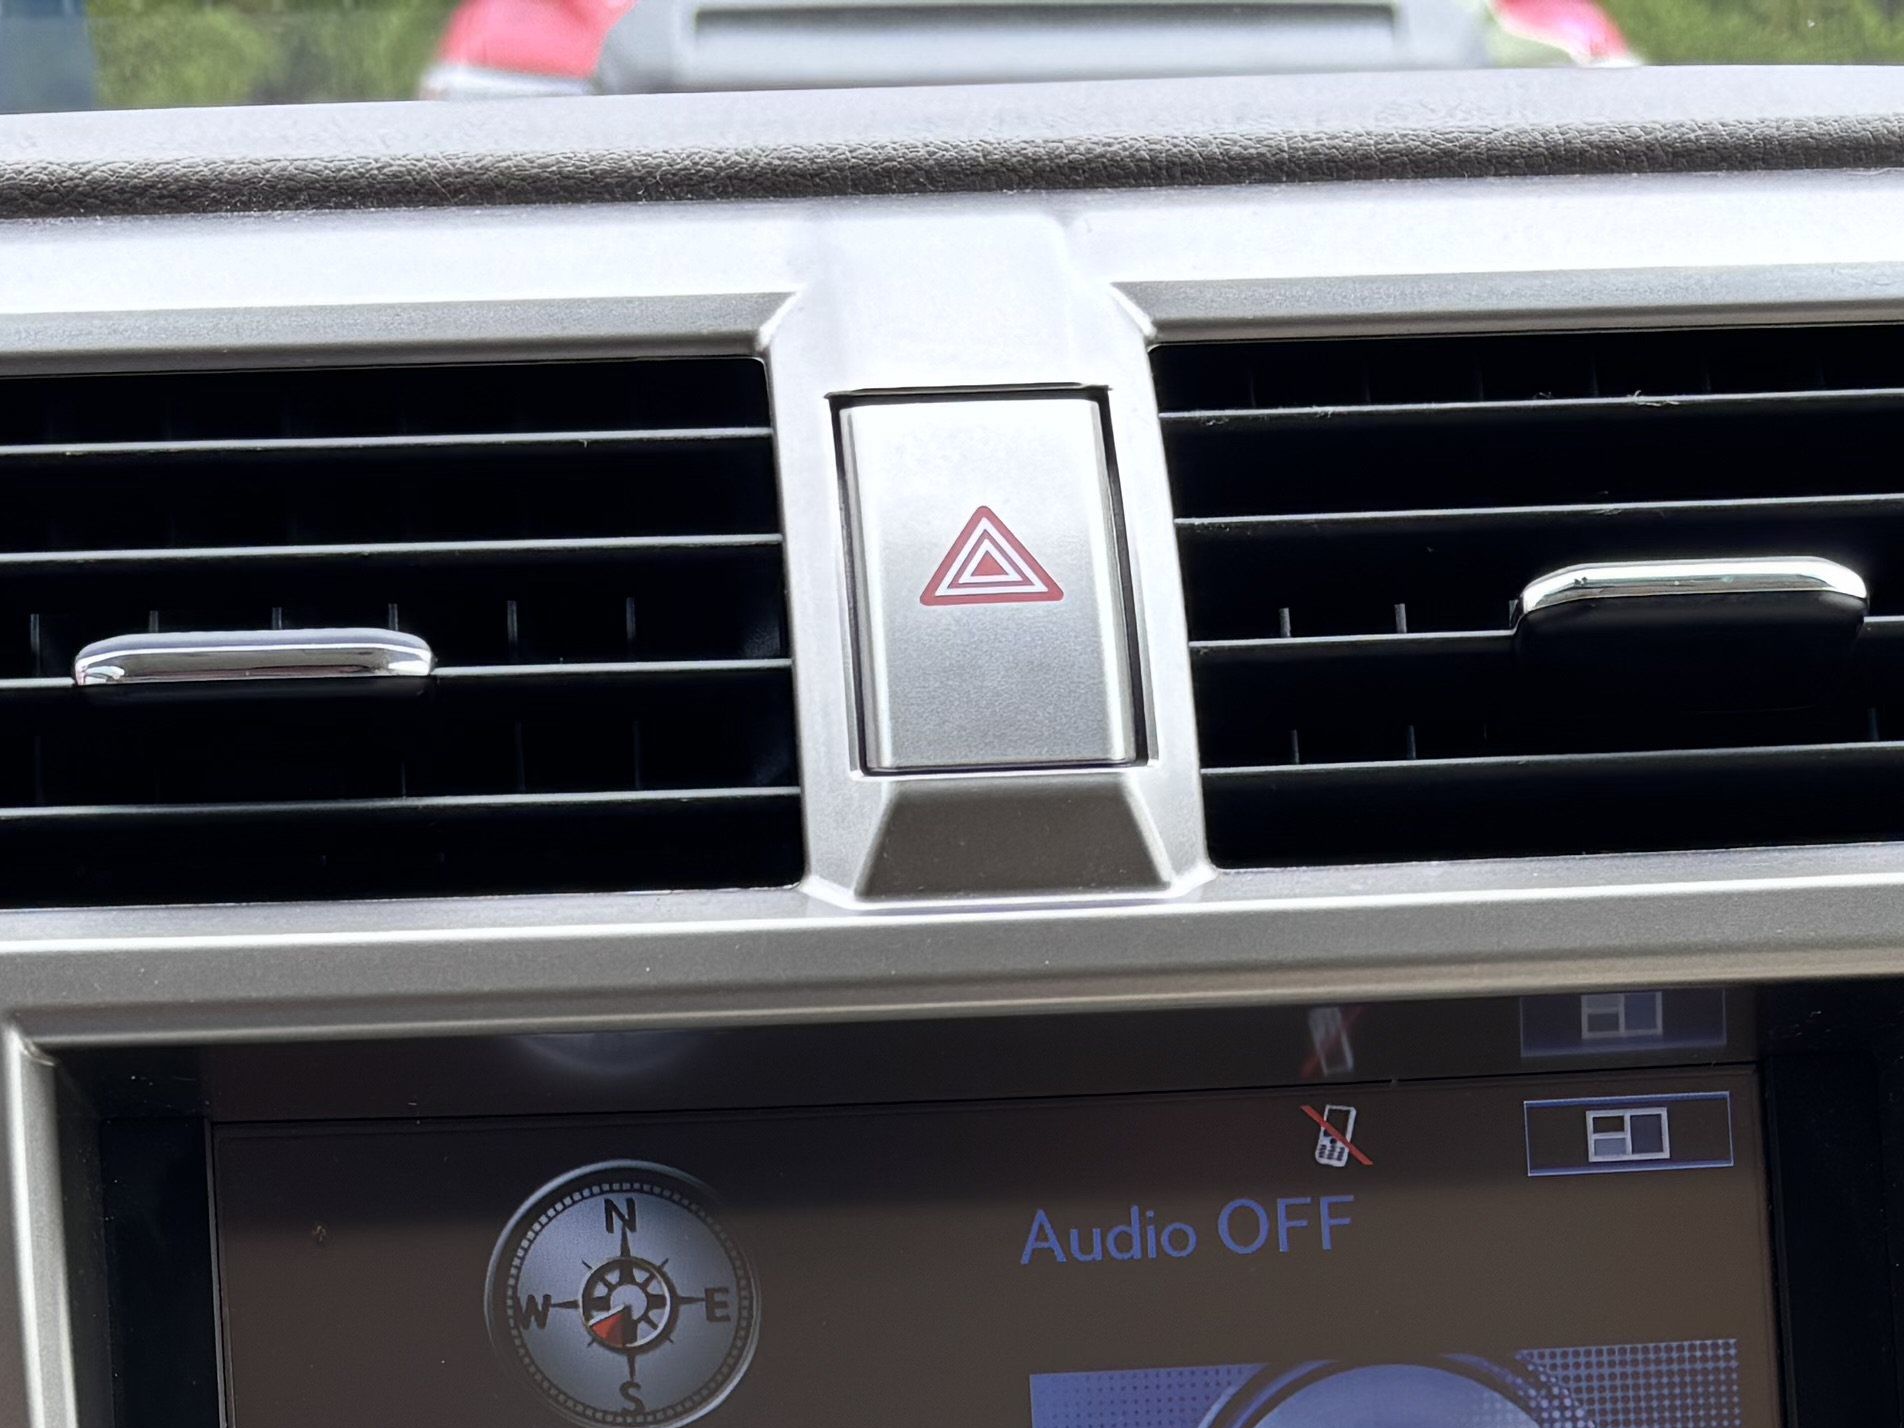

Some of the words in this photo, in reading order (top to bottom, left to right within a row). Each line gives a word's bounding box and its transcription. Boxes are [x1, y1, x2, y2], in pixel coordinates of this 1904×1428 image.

[606, 1199, 638, 1235] N
[1020, 1206, 1197, 1265] Audio
[1216, 1195, 1355, 1255] OFF
[519, 1294, 552, 1330] W
[705, 1288, 731, 1323] E
[620, 1380, 645, 1417] S
